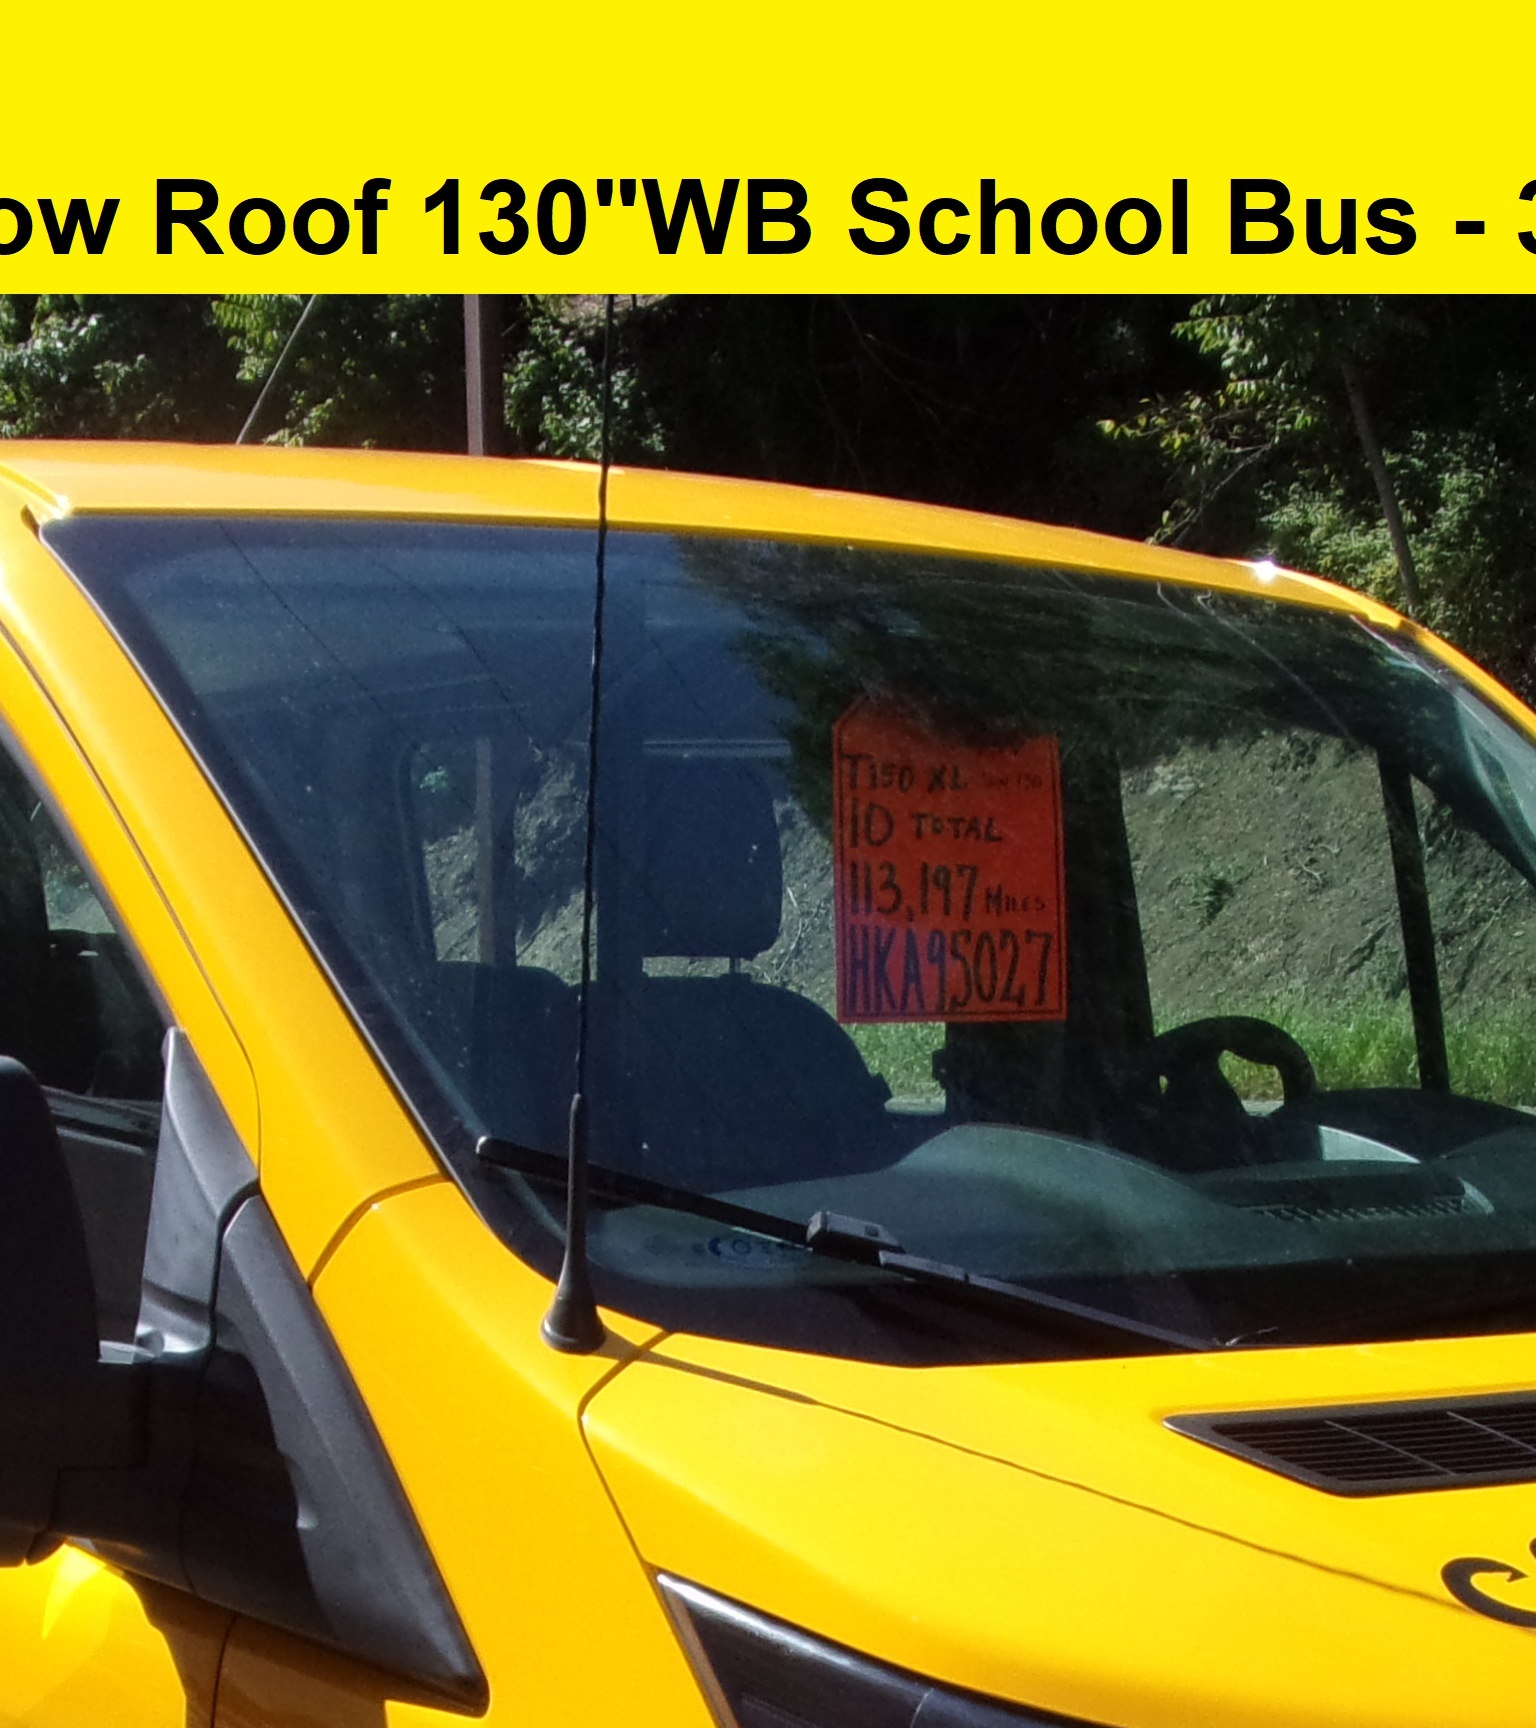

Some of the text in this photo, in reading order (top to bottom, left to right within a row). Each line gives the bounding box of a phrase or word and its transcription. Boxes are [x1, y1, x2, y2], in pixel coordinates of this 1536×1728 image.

[840, 753, 914, 793] T150
[849, 797, 894, 847] 10
[849, 860, 979, 922] 113,197
[847, 924, 1053, 1015] HKA95027
